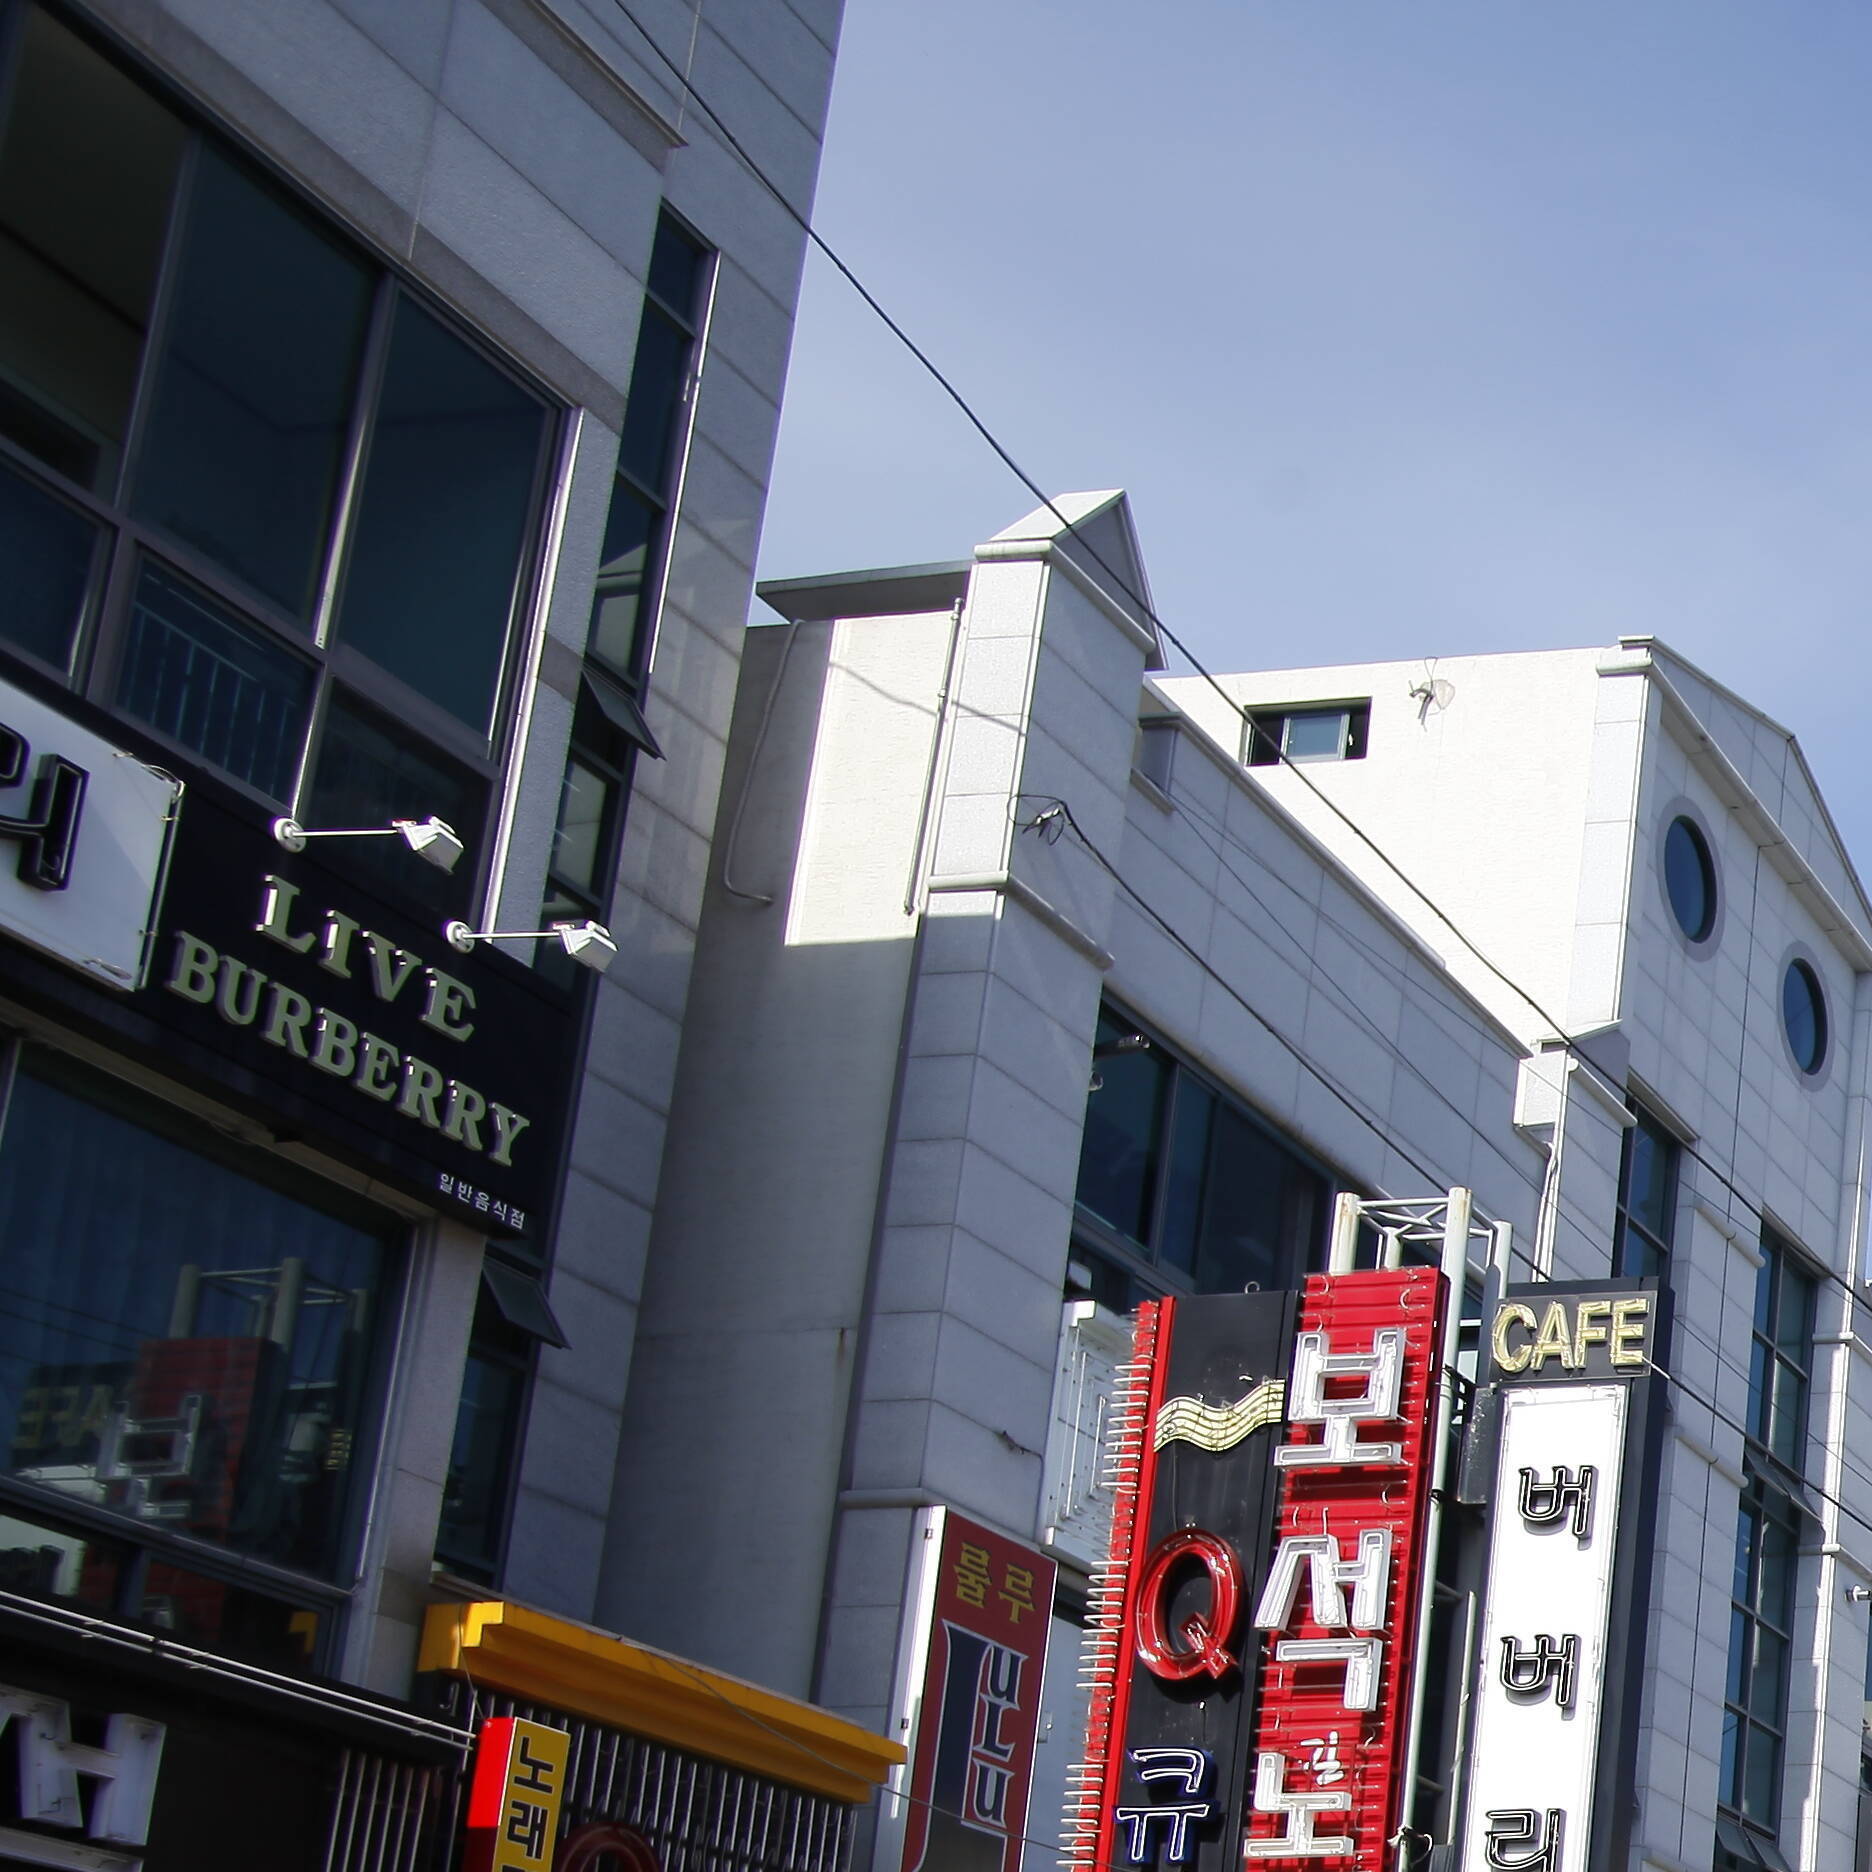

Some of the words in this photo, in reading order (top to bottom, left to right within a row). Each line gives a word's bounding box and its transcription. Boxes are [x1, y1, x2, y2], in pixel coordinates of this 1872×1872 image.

[254, 873, 479, 1042] LIVE
[167, 930, 530, 1167] BURBERRY
[439, 1172, 526, 1231] 일반음식점
[1491, 1297, 1653, 1378] CAFE
[1253, 1328, 1410, 1712] 보석
[1133, 1528, 1239, 1683] Q
[1113, 1746, 1209, 1866] 큐
